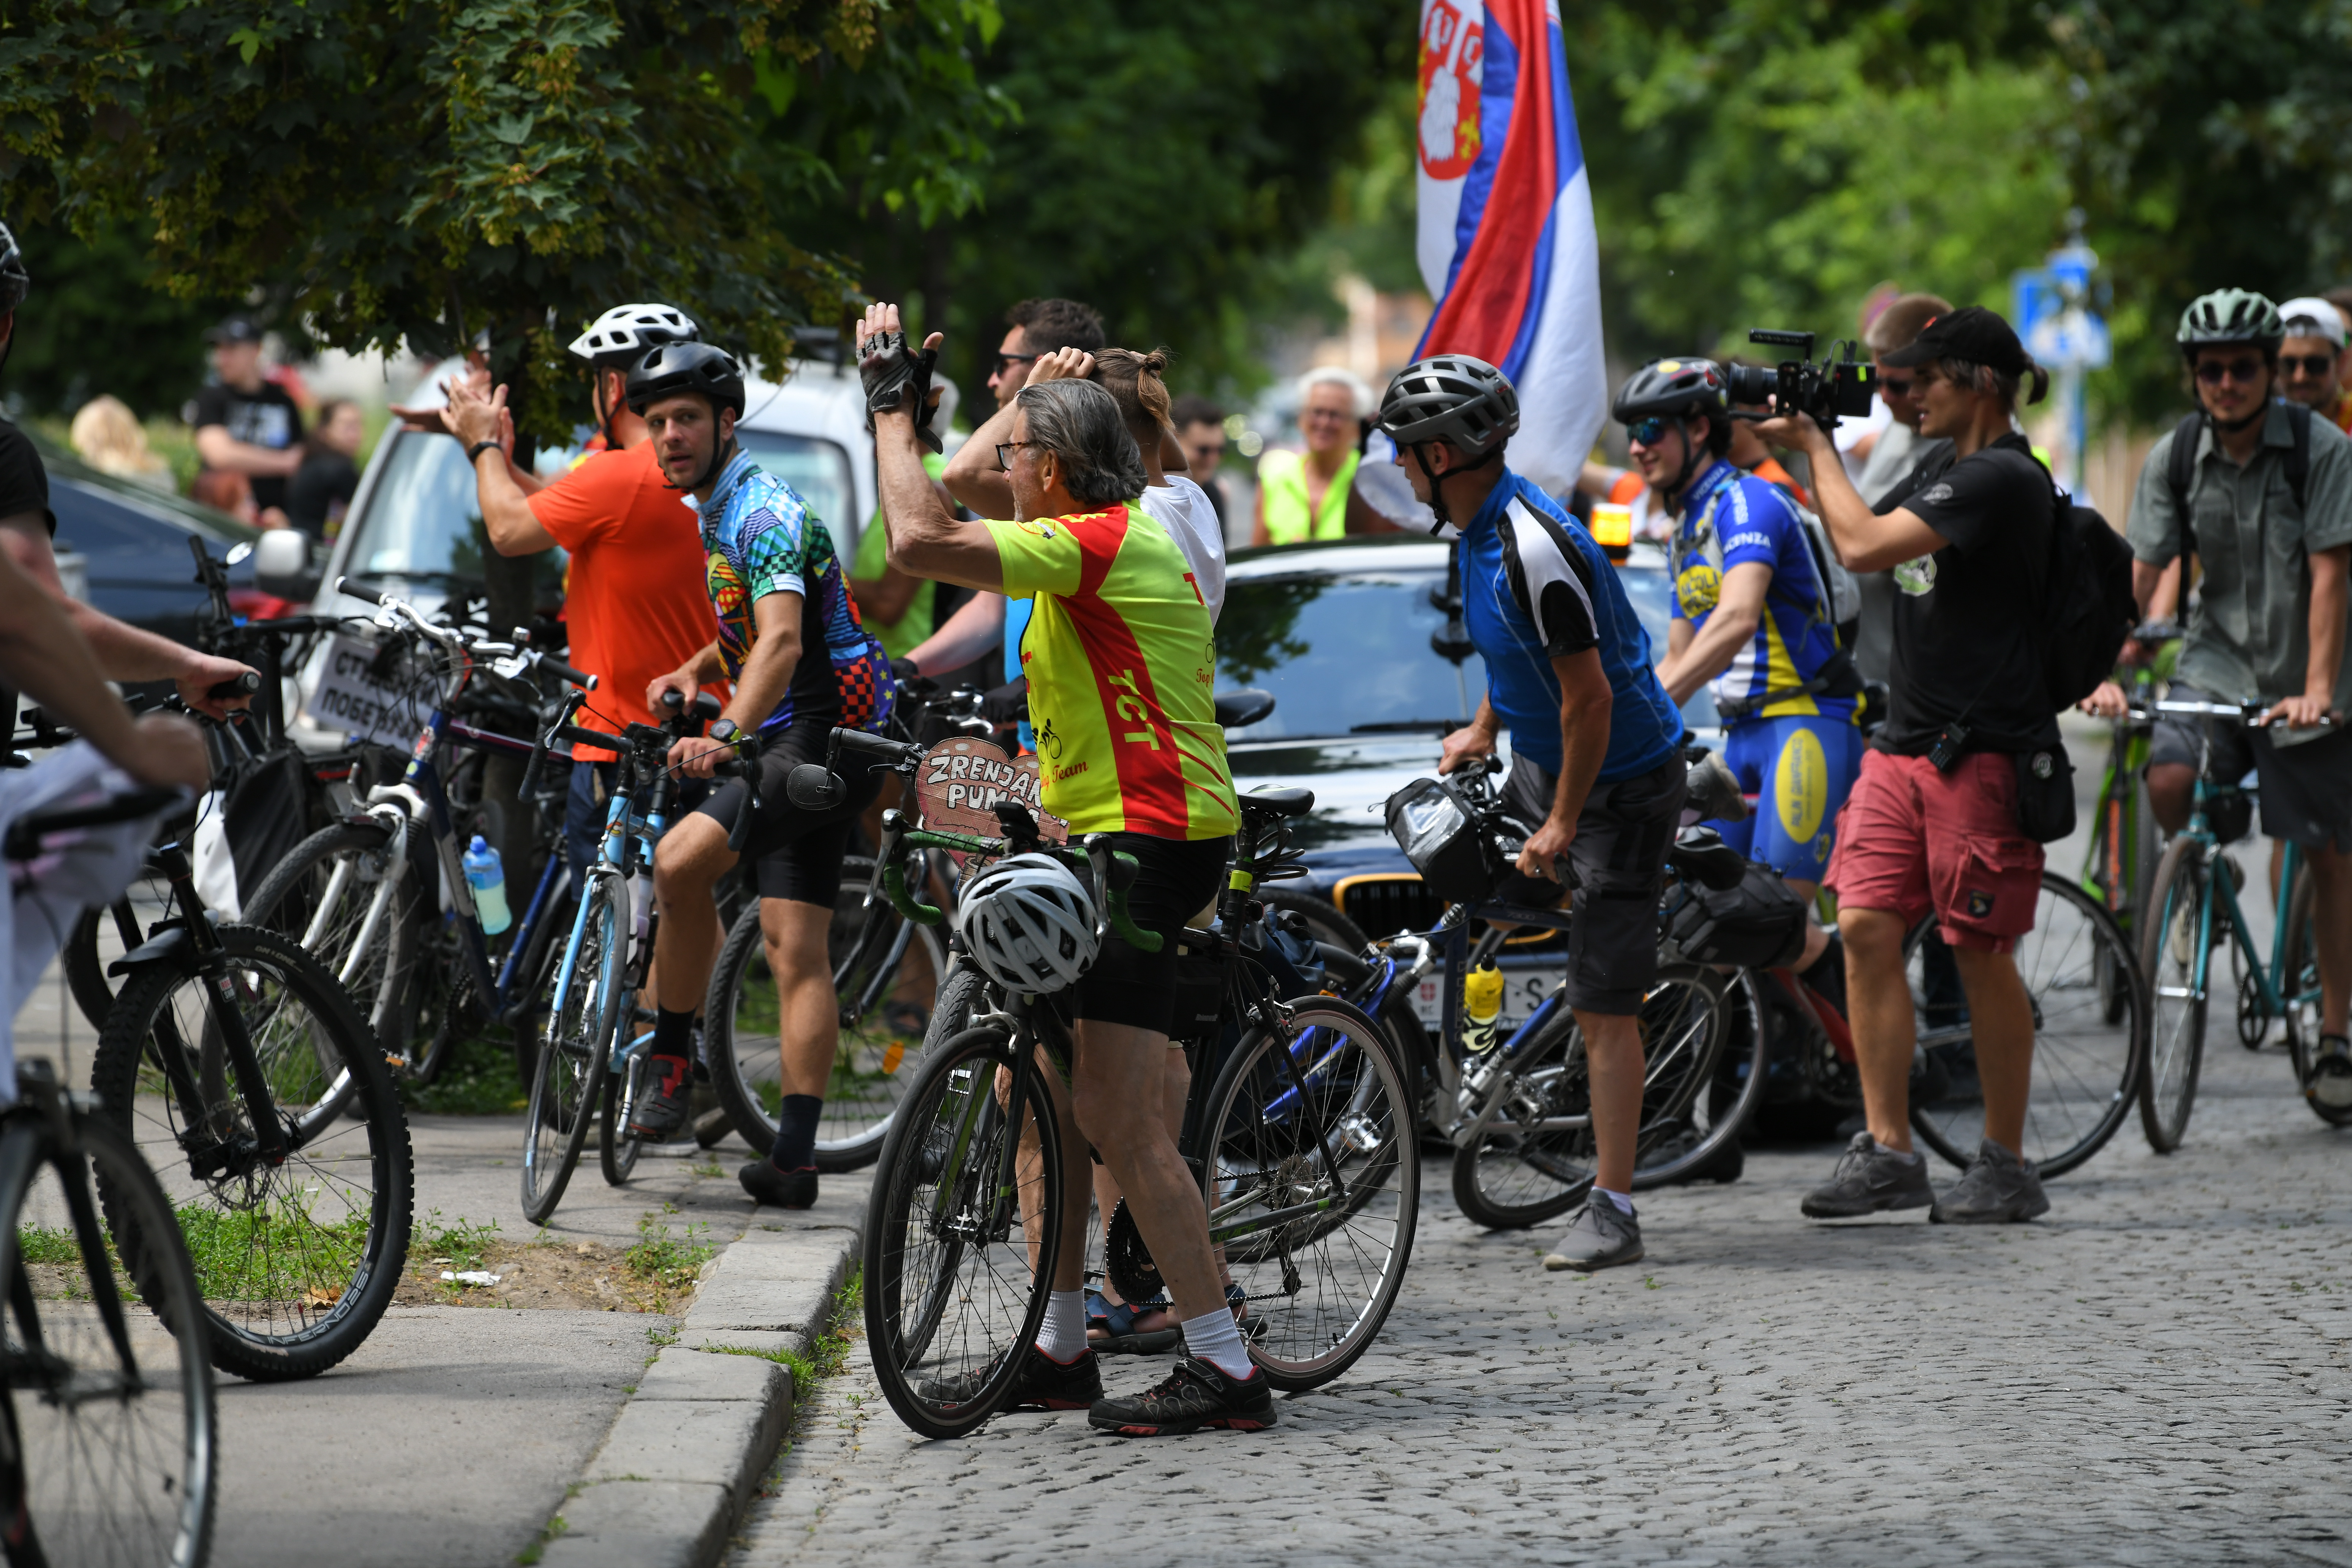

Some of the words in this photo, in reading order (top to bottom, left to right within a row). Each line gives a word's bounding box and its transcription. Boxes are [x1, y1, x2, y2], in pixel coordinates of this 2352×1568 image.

[1196, 668, 1210, 688] Top
[1108, 669, 1160, 751] TCT
[1052, 762, 1089, 783] Team
